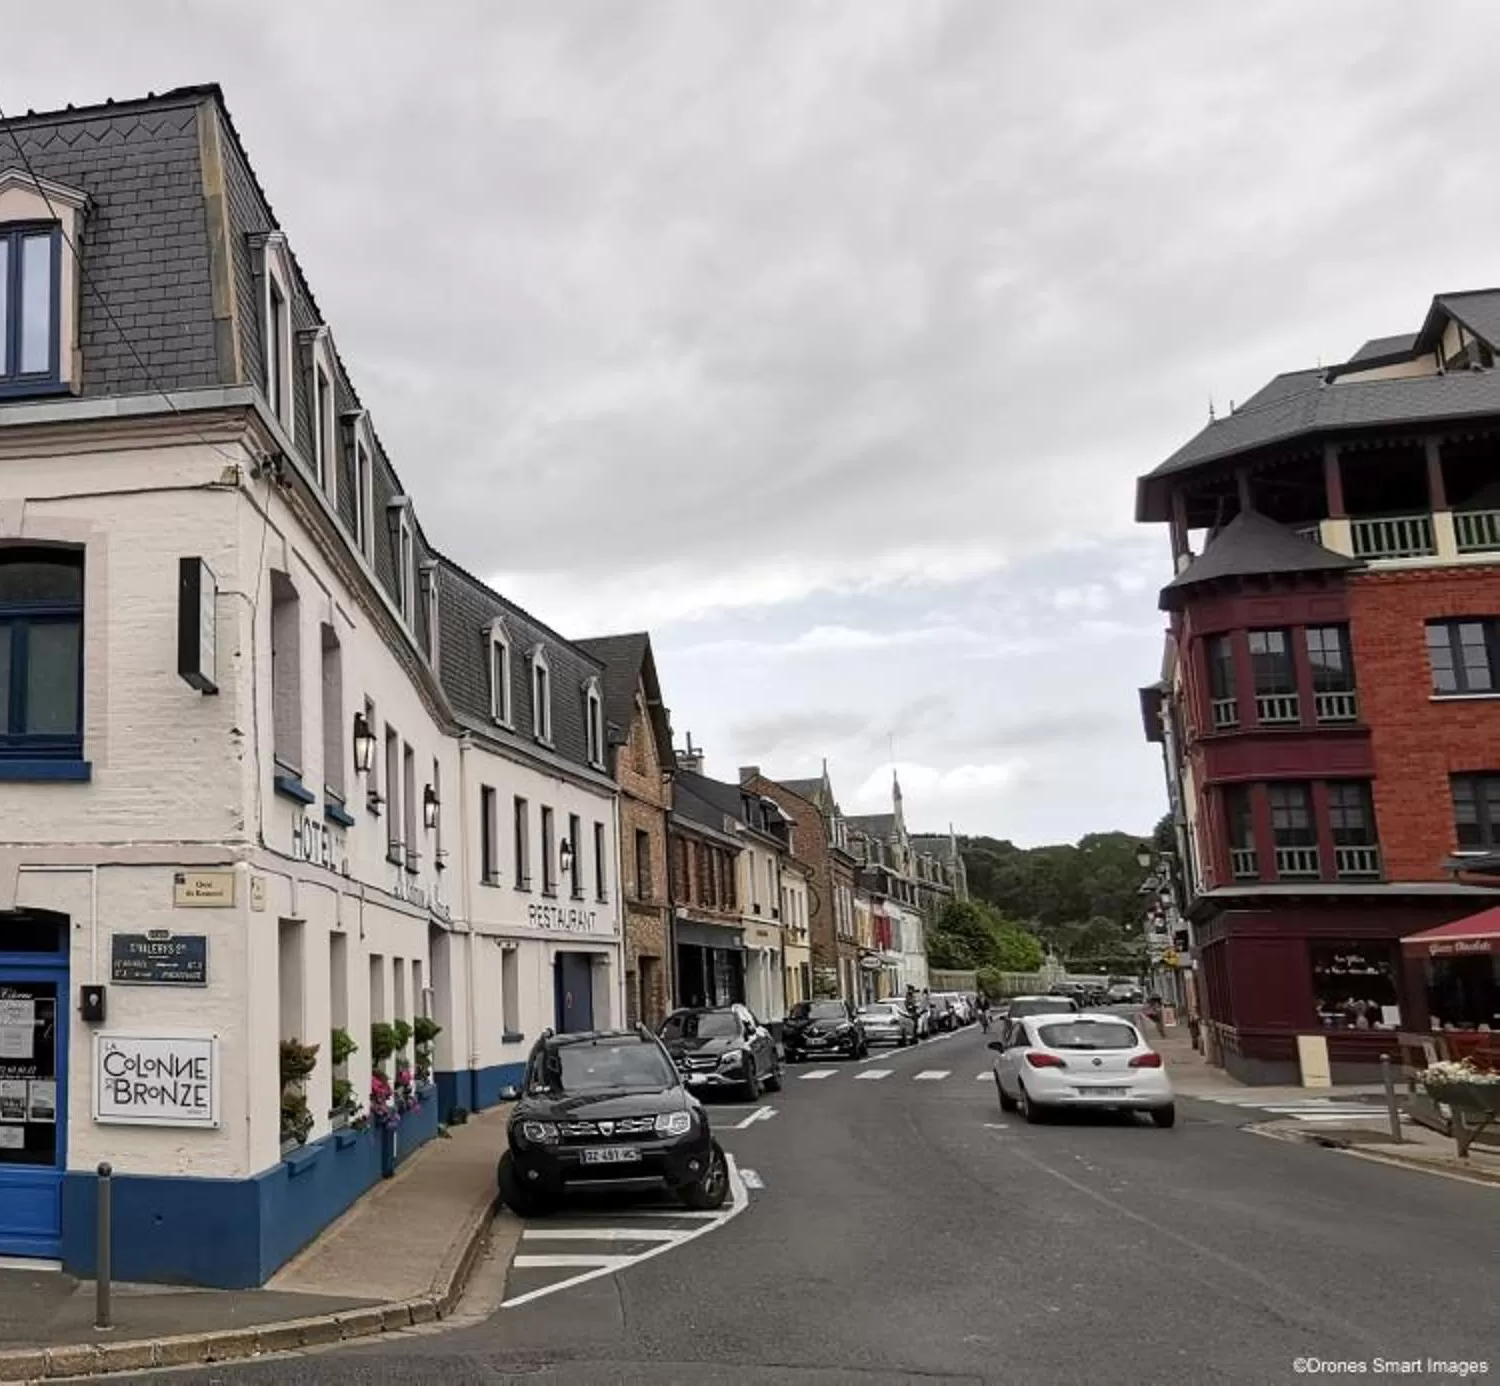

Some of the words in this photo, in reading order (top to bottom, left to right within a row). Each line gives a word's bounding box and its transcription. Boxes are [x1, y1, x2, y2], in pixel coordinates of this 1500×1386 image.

[292, 810, 337, 873] HOTEL
[528, 903, 596, 931] RESTAURANT
[114, 1078, 207, 1107] BRONZE
